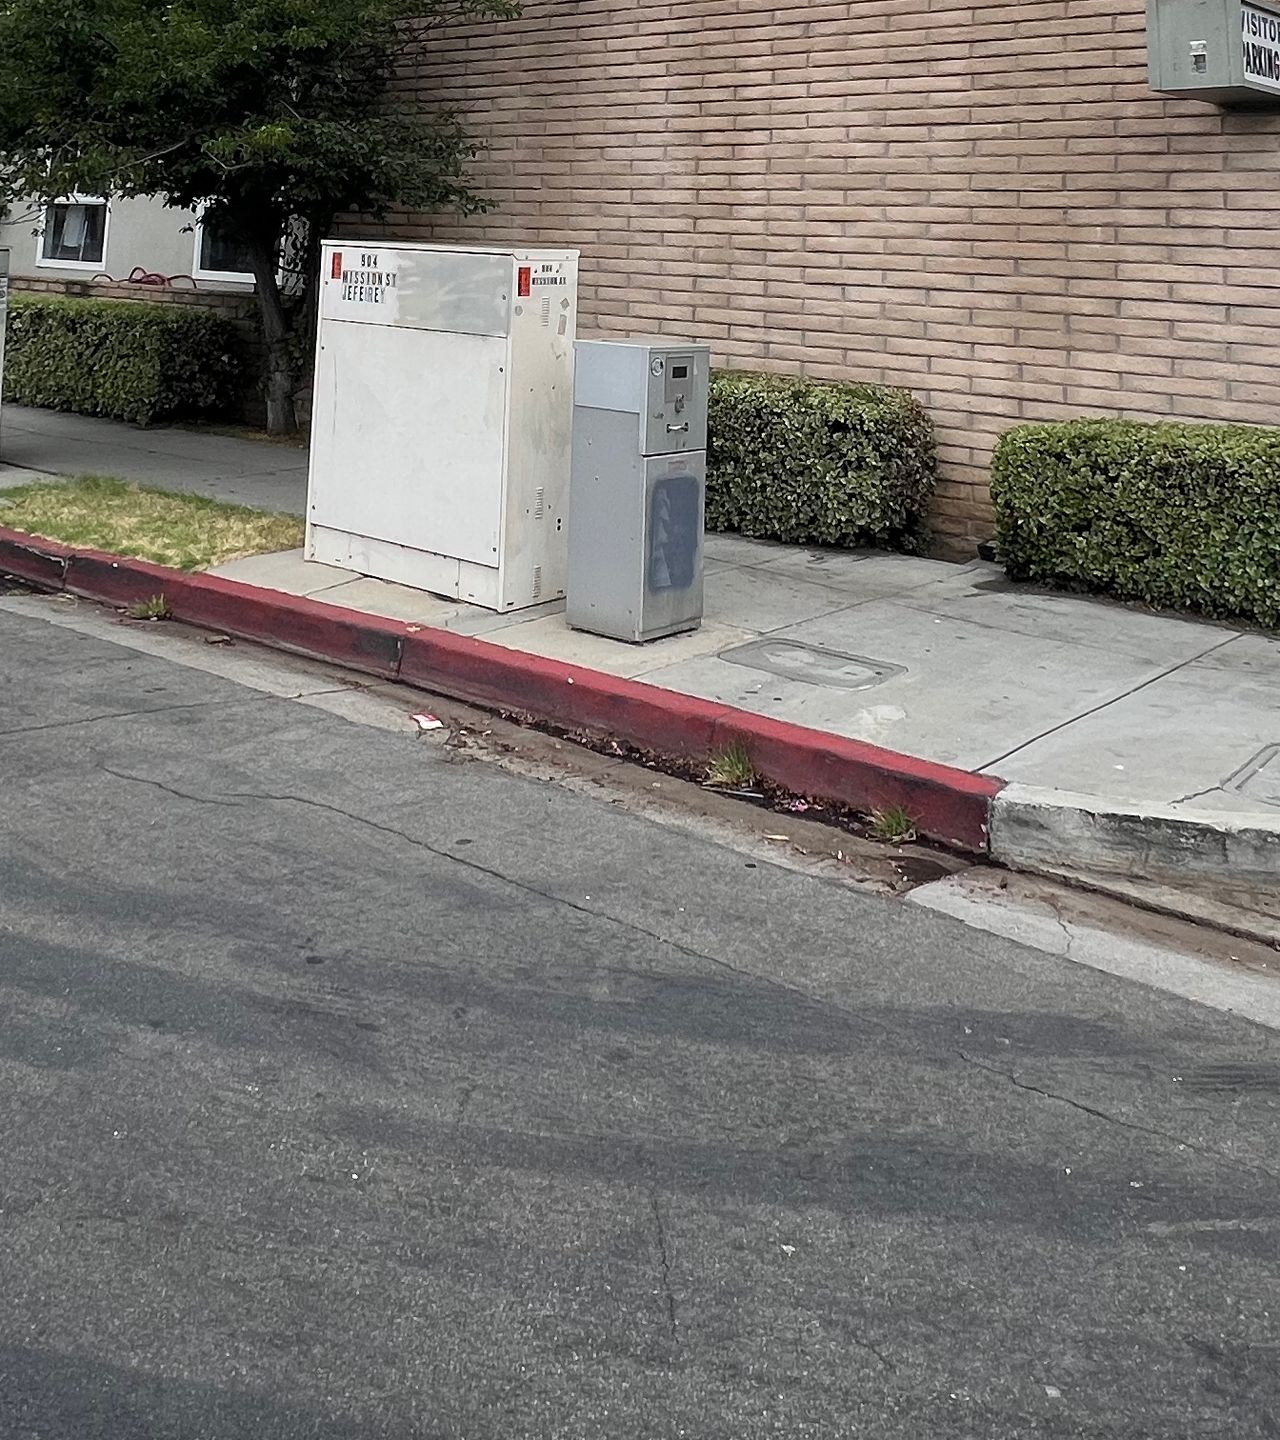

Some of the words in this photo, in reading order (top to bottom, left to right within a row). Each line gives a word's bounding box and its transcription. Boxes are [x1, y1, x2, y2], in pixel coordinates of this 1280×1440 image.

[1243, 41, 1280, 81] ARKING
[361, 254, 377, 268] 904
[343, 270, 383, 285] MISSION
[385, 273, 397, 287] ST
